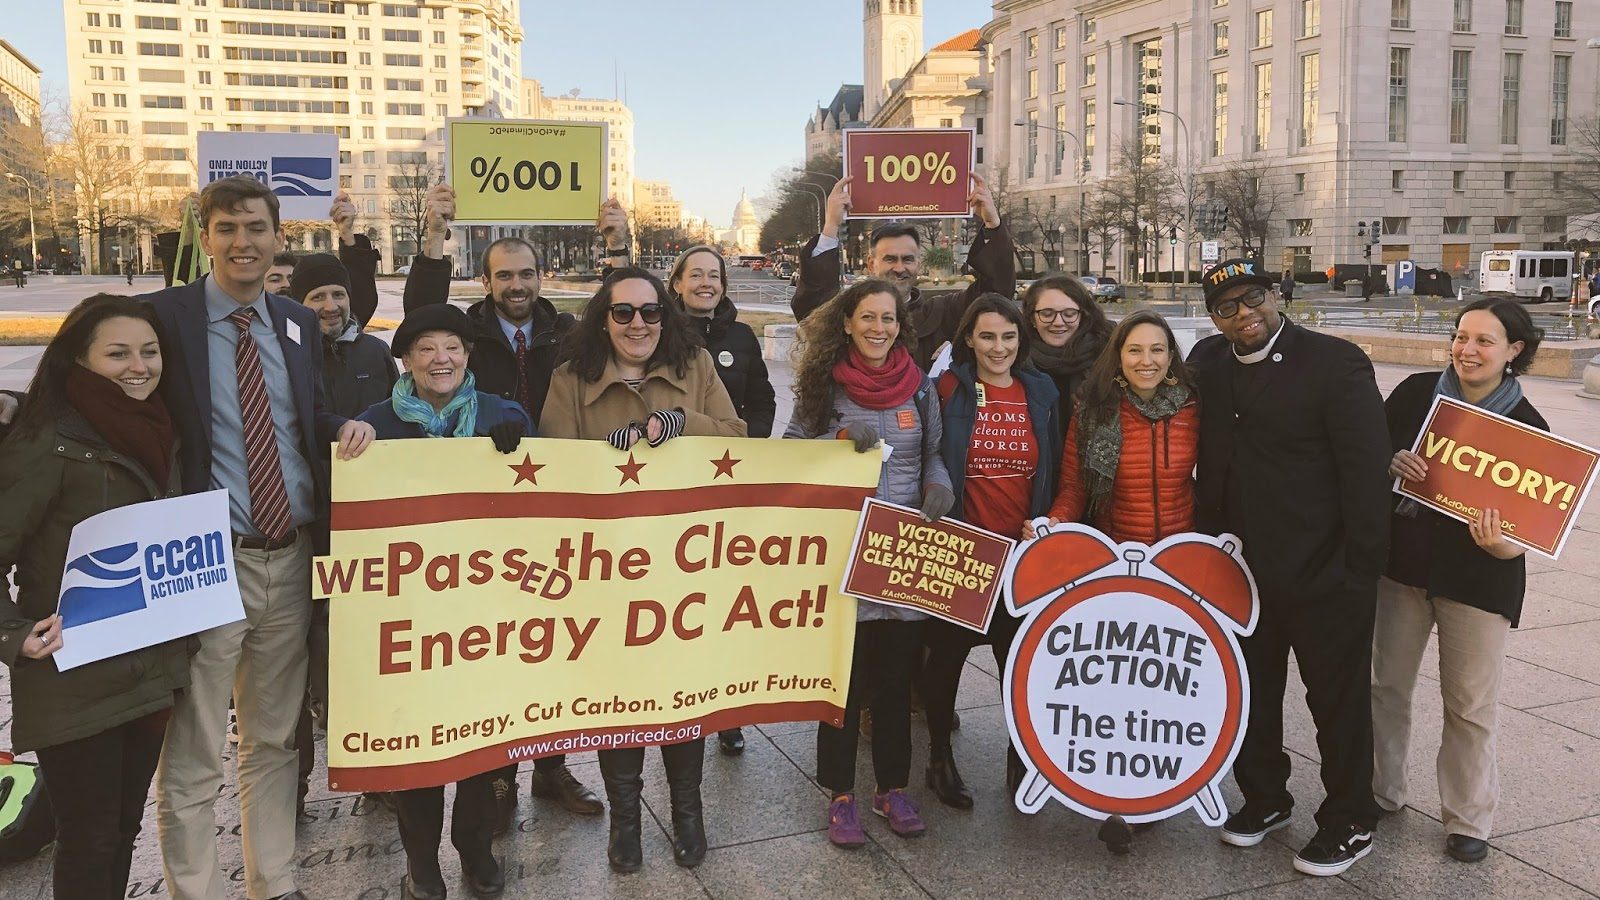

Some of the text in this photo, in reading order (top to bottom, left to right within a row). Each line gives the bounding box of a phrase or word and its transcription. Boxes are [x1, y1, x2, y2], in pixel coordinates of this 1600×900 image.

[489, 127, 566, 137] #ActOnClimateDC
[208, 159, 268, 170] ACTION FUND
[470, 156, 582, 193] 100%
[863, 151, 957, 185] 100%
[878, 204, 940, 212] #ActOnClimateDC
[1209, 262, 1256, 286] THINK
[1399, 260, 1413, 279] P
[975, 423, 1028, 437] clean air
[976, 411, 1026, 423] MOMS
[972, 439, 1029, 452] FORCE
[1424, 431, 1577, 511] VICTORY!
[1435, 492, 1517, 532] #ActOnCliDC
[144, 530, 225, 581] ccan
[867, 531, 996, 580] WE PASSED THE
[898, 521, 976, 556] VICTORY!
[316, 557, 384, 595] WE
[555, 531, 651, 581] the
[674, 521, 828, 574] Clean
[862, 549, 992, 594] CLEAN ENERGY
[150, 567, 228, 600] ACTION FUND
[881, 588, 952, 613] #ActOnClimateDC
[887, 571, 955, 600] DC ACT!
[379, 584, 829, 676] Energy DC Act!
[1046, 620, 1207, 667] CLIMATE
[1054, 654, 1199, 698] ACTION:
[342, 674, 837, 753] Clean Energy. Cut Carbon. Save our Future.
[1046, 702, 1207, 747] The time
[507, 723, 702, 760] www.carbonpricedc.org
[1067, 740, 1183, 781] is now
